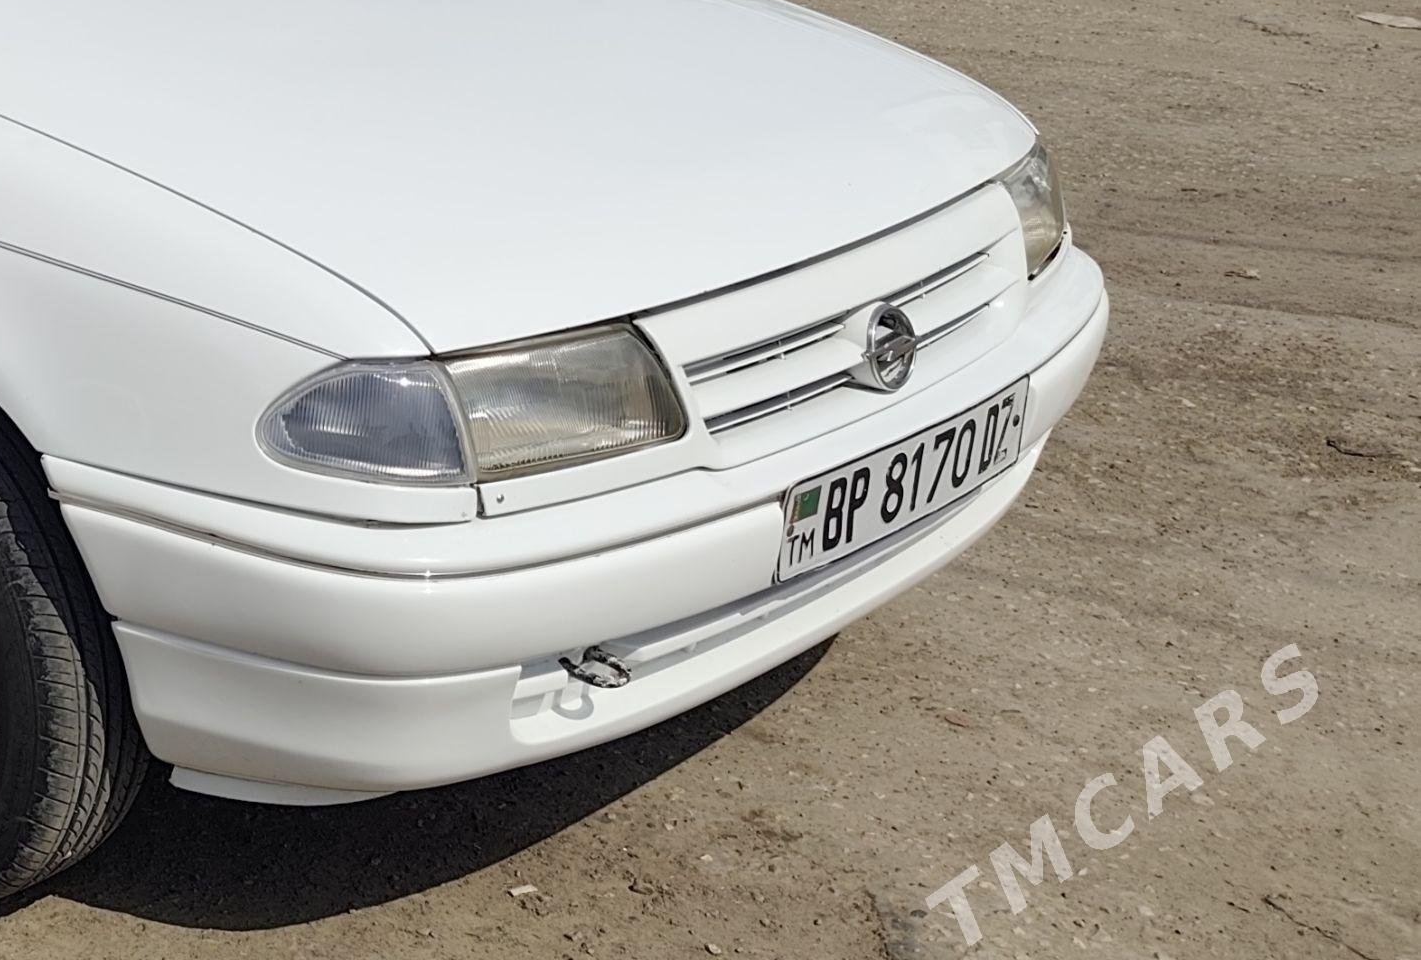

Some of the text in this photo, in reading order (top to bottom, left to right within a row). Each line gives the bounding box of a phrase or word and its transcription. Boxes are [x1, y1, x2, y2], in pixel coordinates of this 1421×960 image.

[822, 394, 1015, 552] BP 8170 DZ
[786, 527, 815, 567] TM
